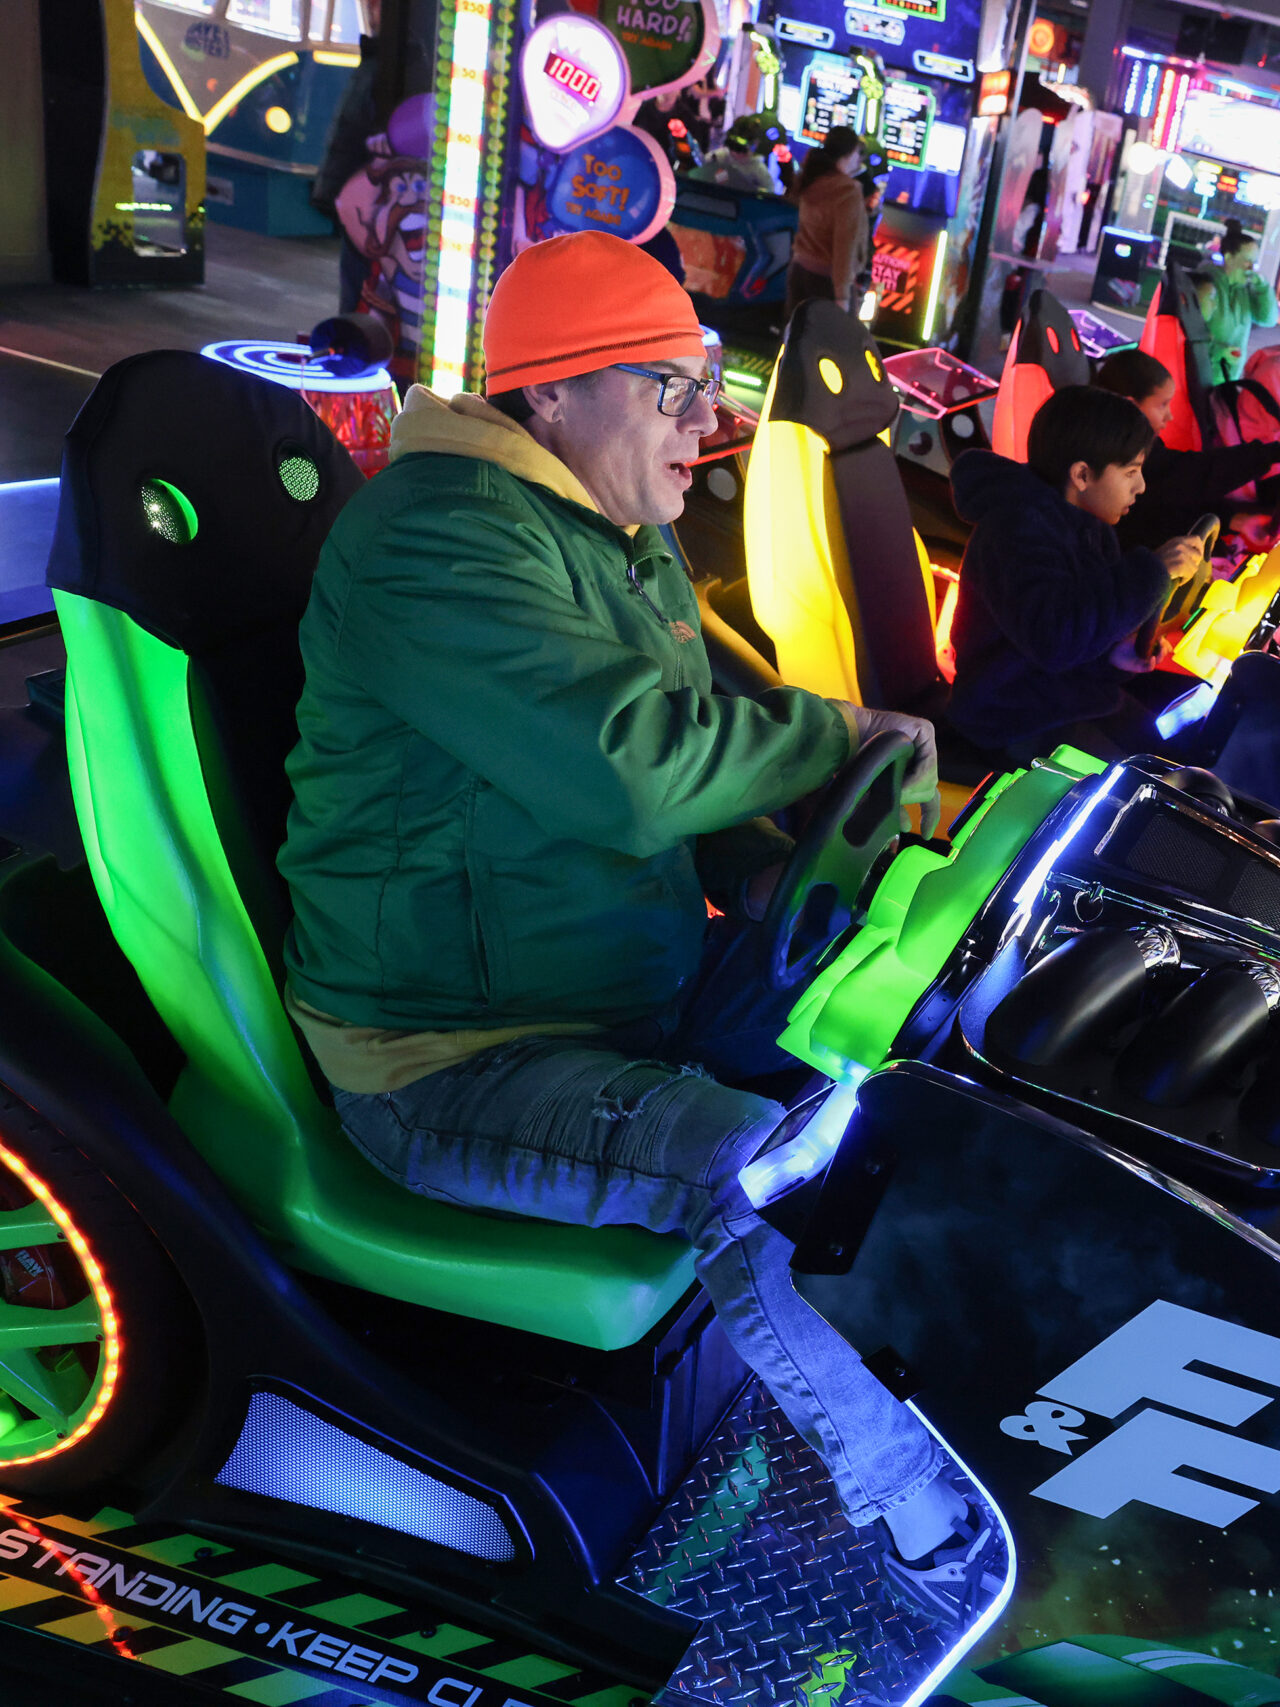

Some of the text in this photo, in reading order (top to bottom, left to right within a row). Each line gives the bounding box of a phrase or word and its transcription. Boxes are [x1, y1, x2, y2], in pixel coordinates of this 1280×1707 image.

[617, 5, 691, 42] HARD!
[549, 57, 601, 100] 1000
[582, 154, 622, 181] TOO
[572, 174, 630, 211] SOFT!
[0, 1528, 256, 1635] STANDING
[266, 1621, 419, 1684] KEEP
